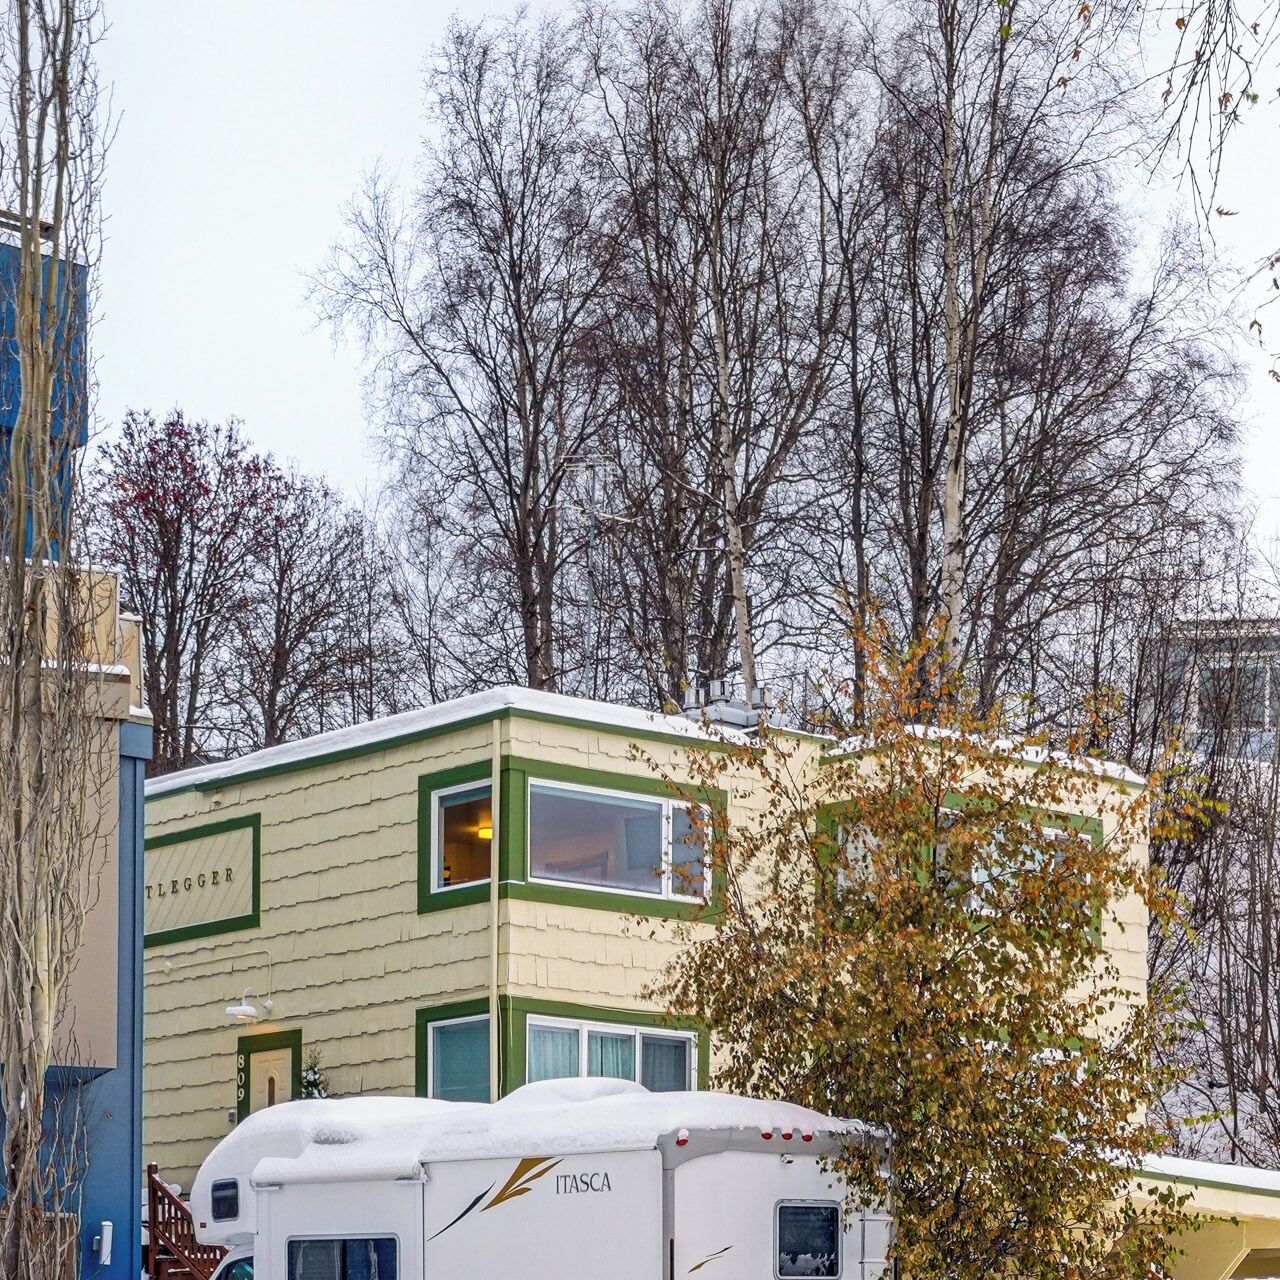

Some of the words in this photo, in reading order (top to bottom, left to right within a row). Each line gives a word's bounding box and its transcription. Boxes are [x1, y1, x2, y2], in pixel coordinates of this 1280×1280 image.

[145, 867, 233, 899] TLEGGER
[237, 1054, 246, 1101] 809
[555, 1172, 612, 1195] ITASCA
